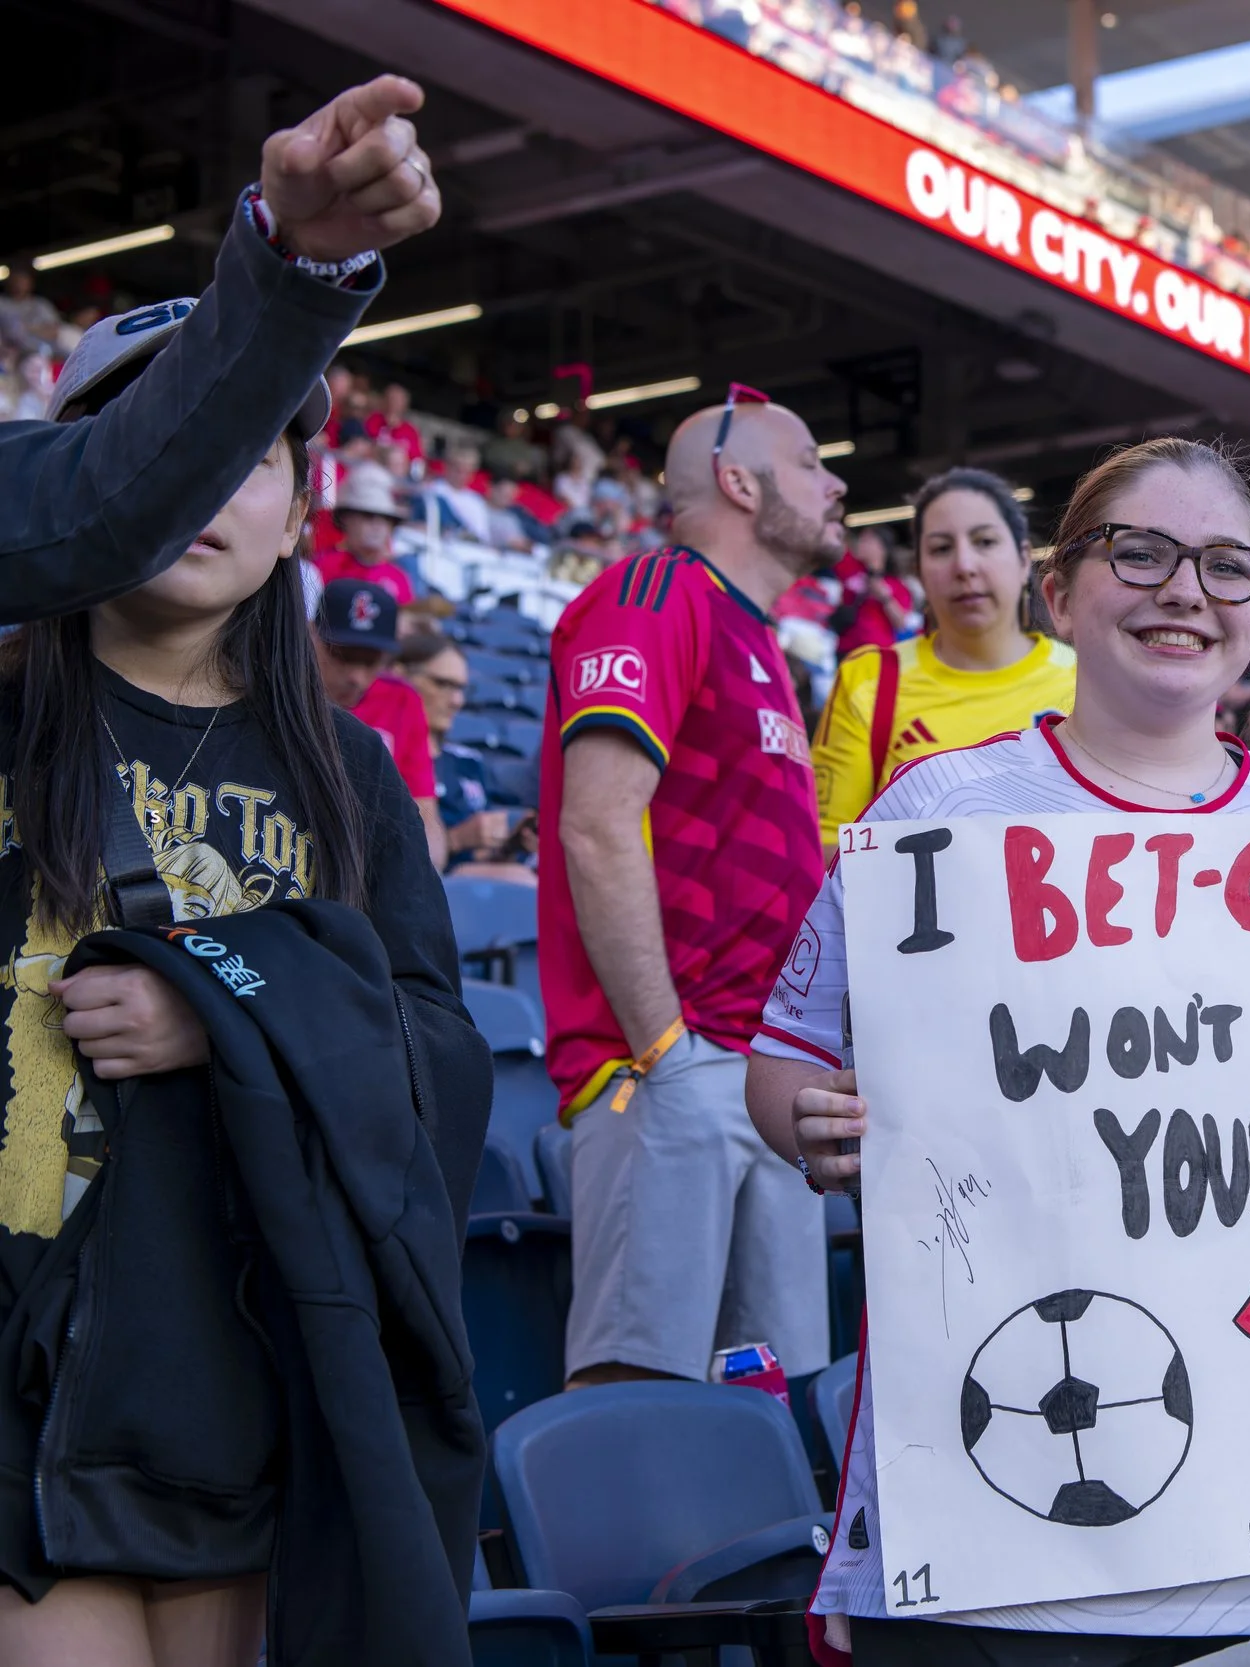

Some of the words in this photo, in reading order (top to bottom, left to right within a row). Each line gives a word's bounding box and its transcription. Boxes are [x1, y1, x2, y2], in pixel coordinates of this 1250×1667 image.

[905, 148, 1022, 256] OUR
[1030, 210, 1149, 316] CITY.
[1154, 269, 1244, 360] OUR
[577, 652, 641, 693] BJC
[843, 828, 879, 853] 11
[895, 827, 955, 954] I
[989, 993, 1242, 1102] WON'T
[814, 1532, 827, 1547] 19
[893, 1563, 940, 1607] 11
